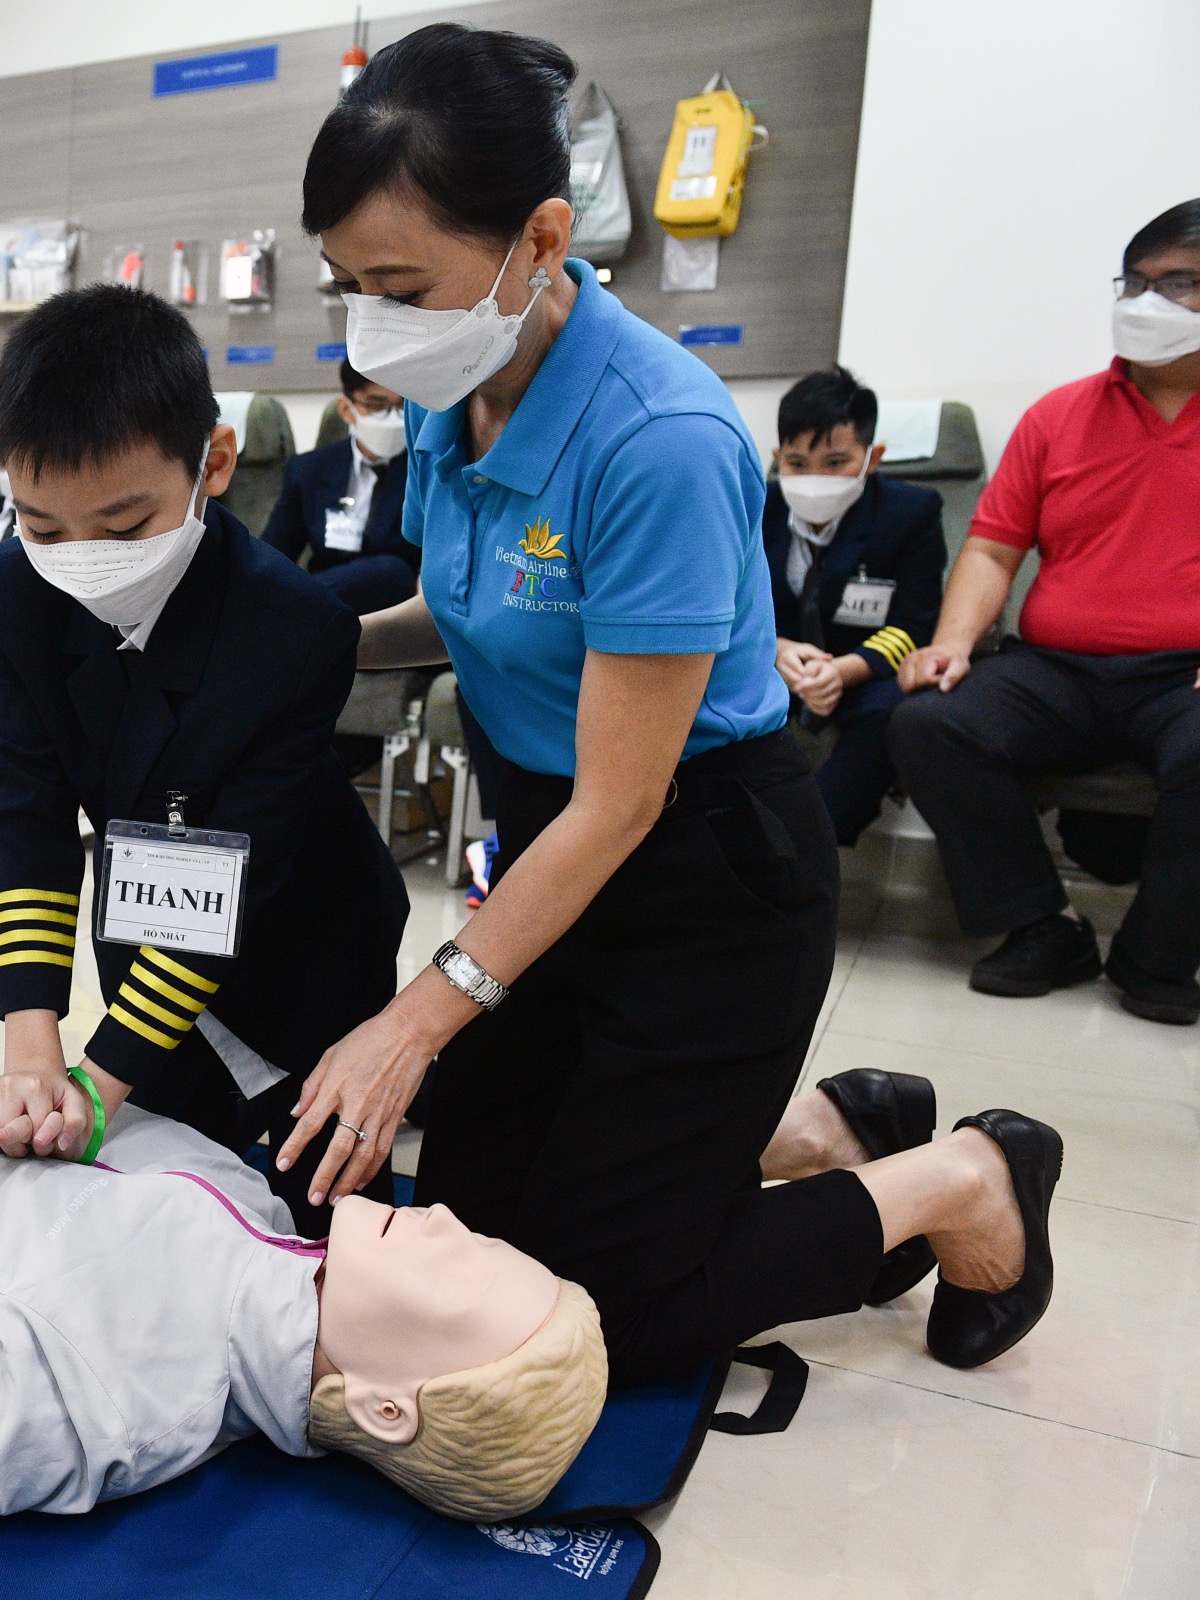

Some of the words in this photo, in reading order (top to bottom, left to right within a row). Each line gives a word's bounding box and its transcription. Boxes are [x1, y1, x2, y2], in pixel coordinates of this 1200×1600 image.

[495, 546, 527, 570] Vietnam
[528, 558, 571, 579] Airline
[502, 592, 580, 613] INSTRUCTOR
[115, 879, 225, 915] THANH
[69, 1177, 109, 1215] Resusci
[46, 1210, 73, 1240] Anne
